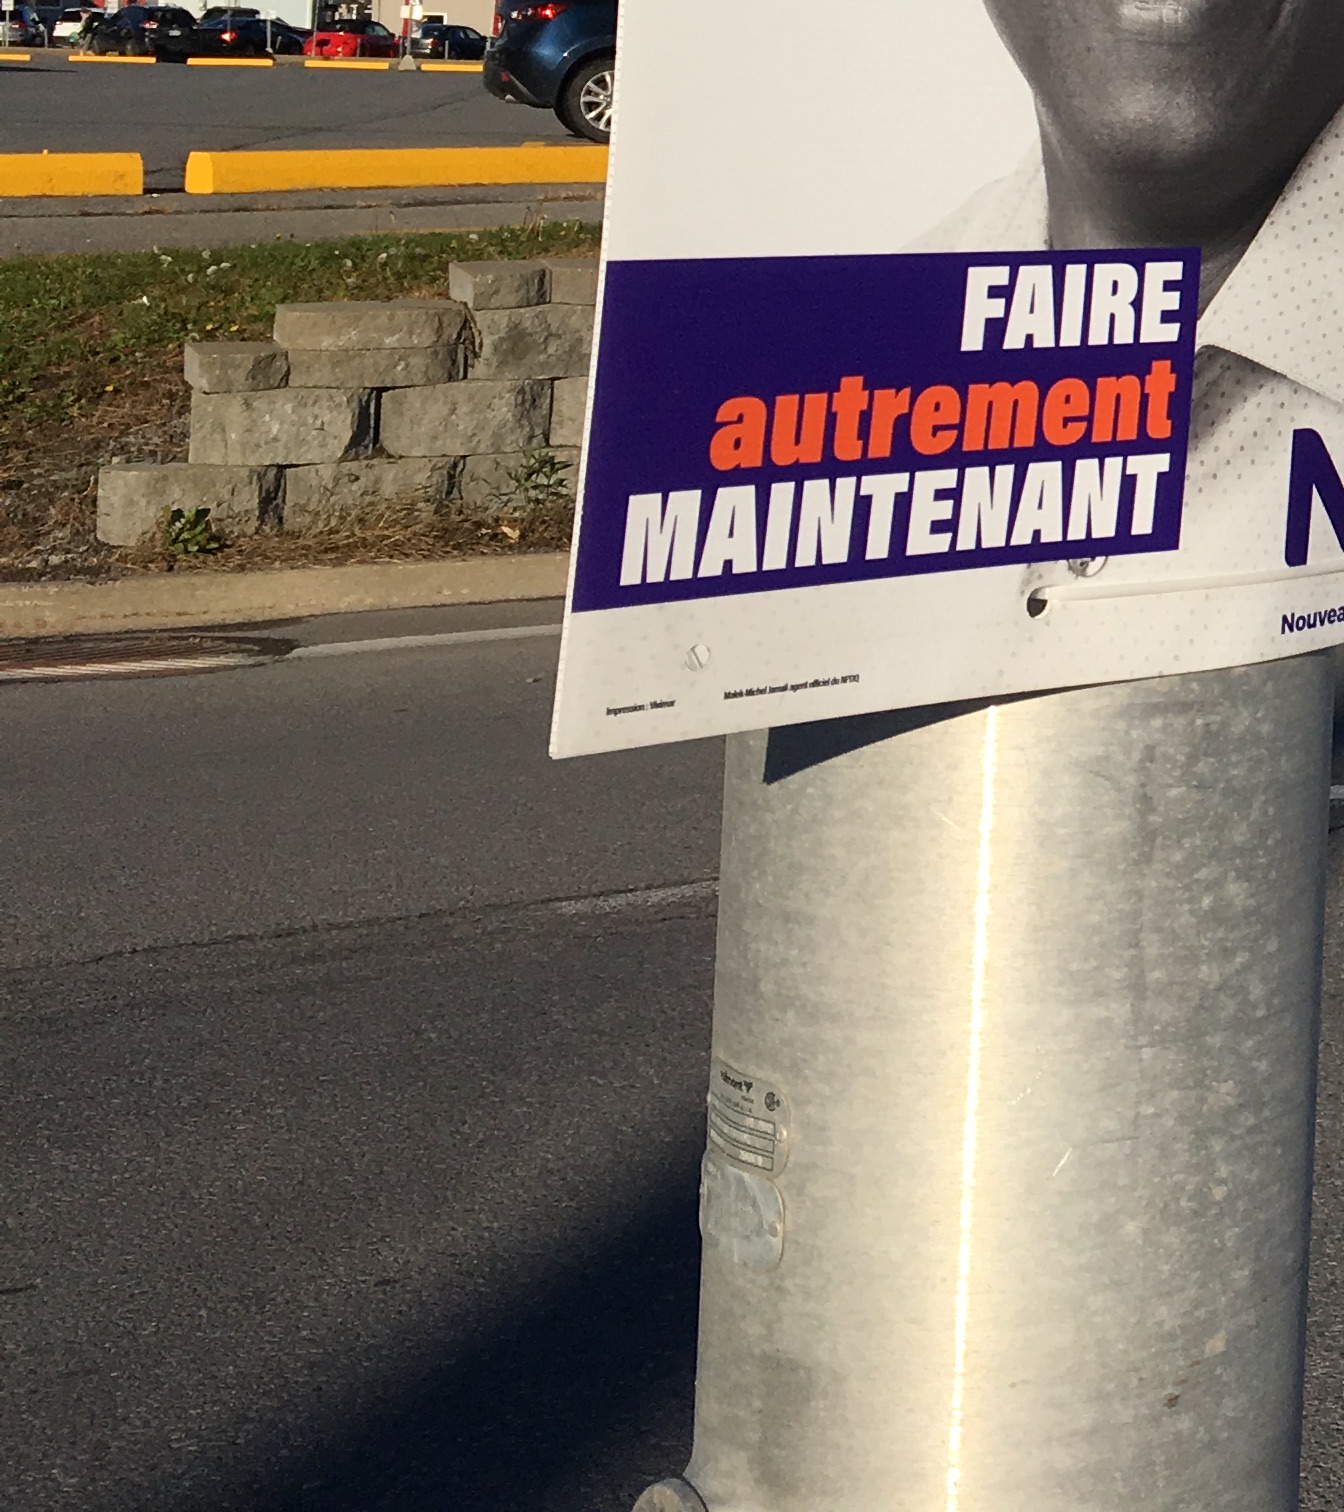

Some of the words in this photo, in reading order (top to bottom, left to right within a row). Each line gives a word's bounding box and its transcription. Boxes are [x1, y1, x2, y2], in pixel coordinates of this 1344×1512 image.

[960, 261, 1185, 352] FAIRE
[709, 359, 1179, 472] autrement
[619, 452, 1171, 587] MAINTENANT
